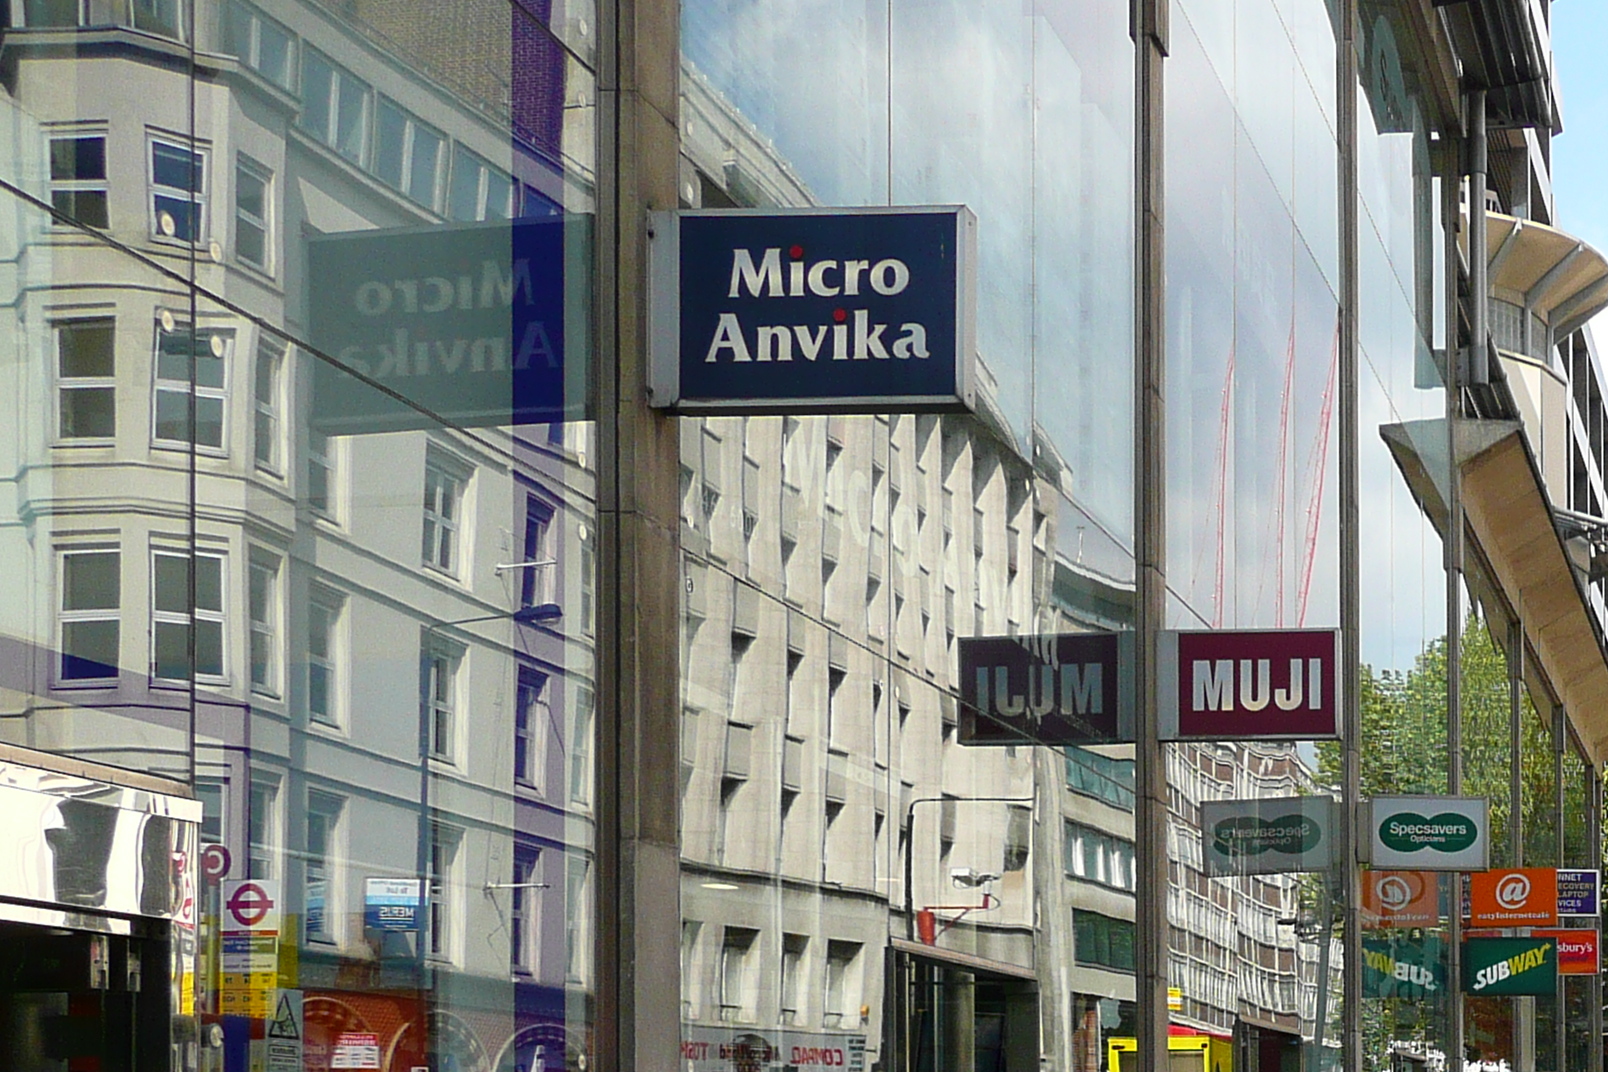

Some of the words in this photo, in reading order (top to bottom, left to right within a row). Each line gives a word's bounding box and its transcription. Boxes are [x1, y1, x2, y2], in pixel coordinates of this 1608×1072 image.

[728, 244, 910, 298] Micro
[705, 307, 930, 363] Anvika
[1192, 657, 1321, 711] MUJI
[1389, 821, 1467, 836] Specsavers
[1410, 835, 1446, 844] Opticians
[1473, 942, 1551, 990] SUBWAY
